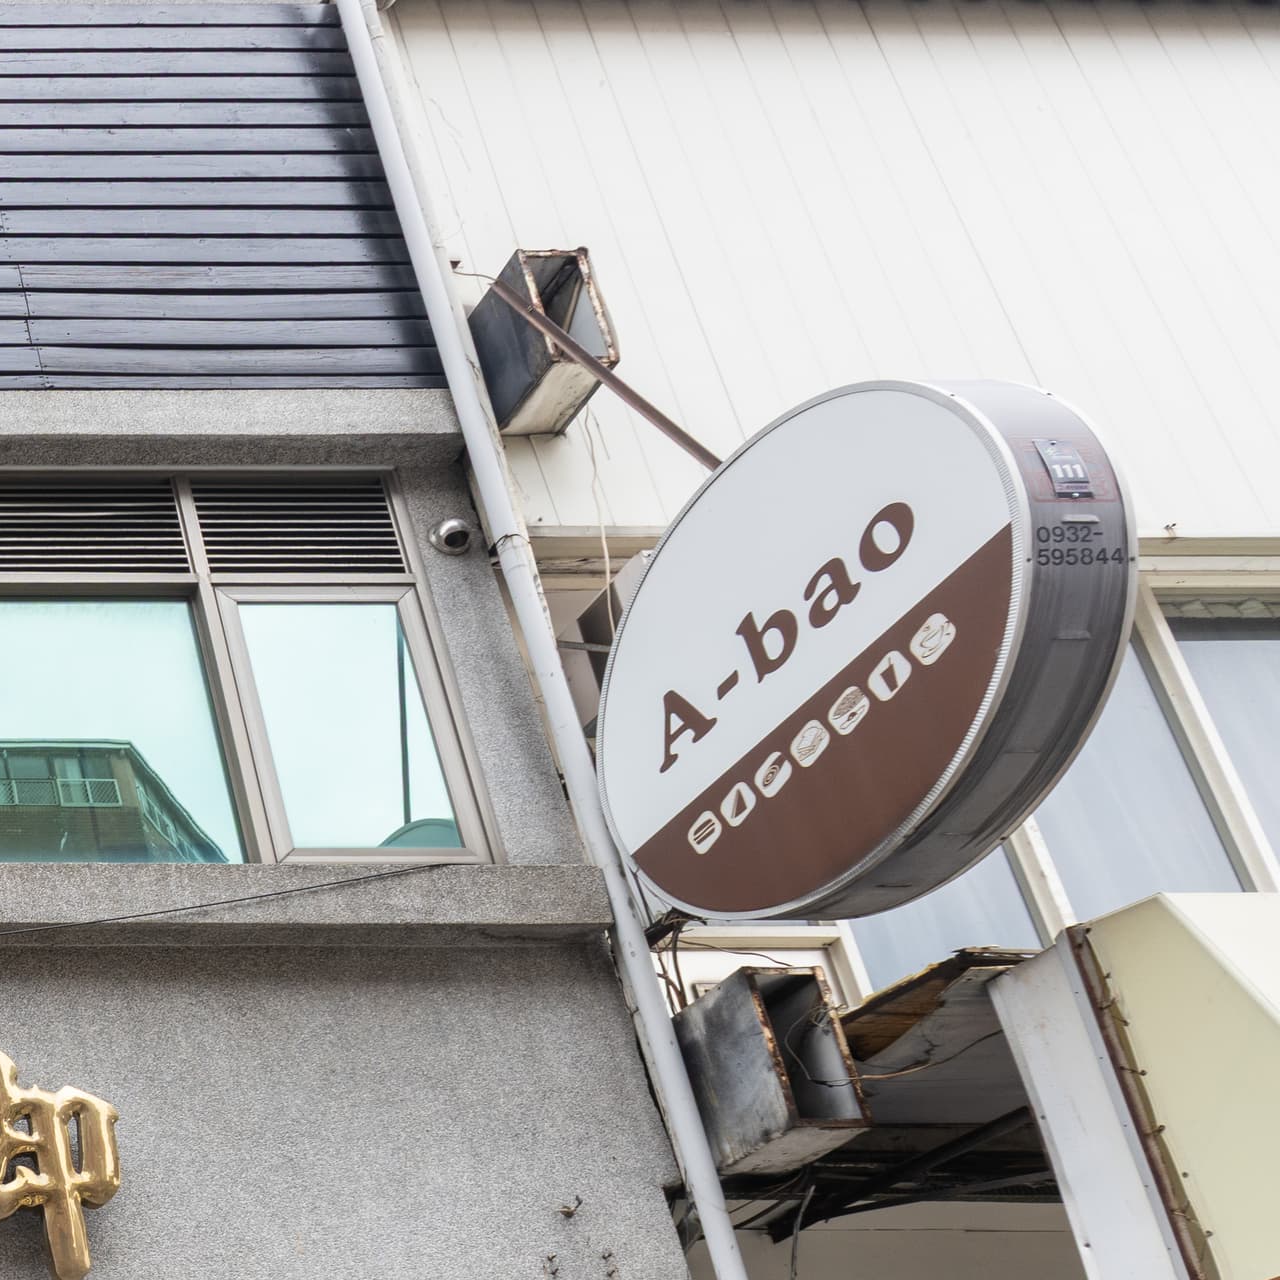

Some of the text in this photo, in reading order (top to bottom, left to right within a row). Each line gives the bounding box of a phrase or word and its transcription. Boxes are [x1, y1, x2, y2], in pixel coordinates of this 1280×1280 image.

[1051, 463, 1085, 479] 111
[1036, 525, 1104, 543] 0932-
[1036, 547, 1124, 567] 595844
[659, 501, 915, 773] A-bao
